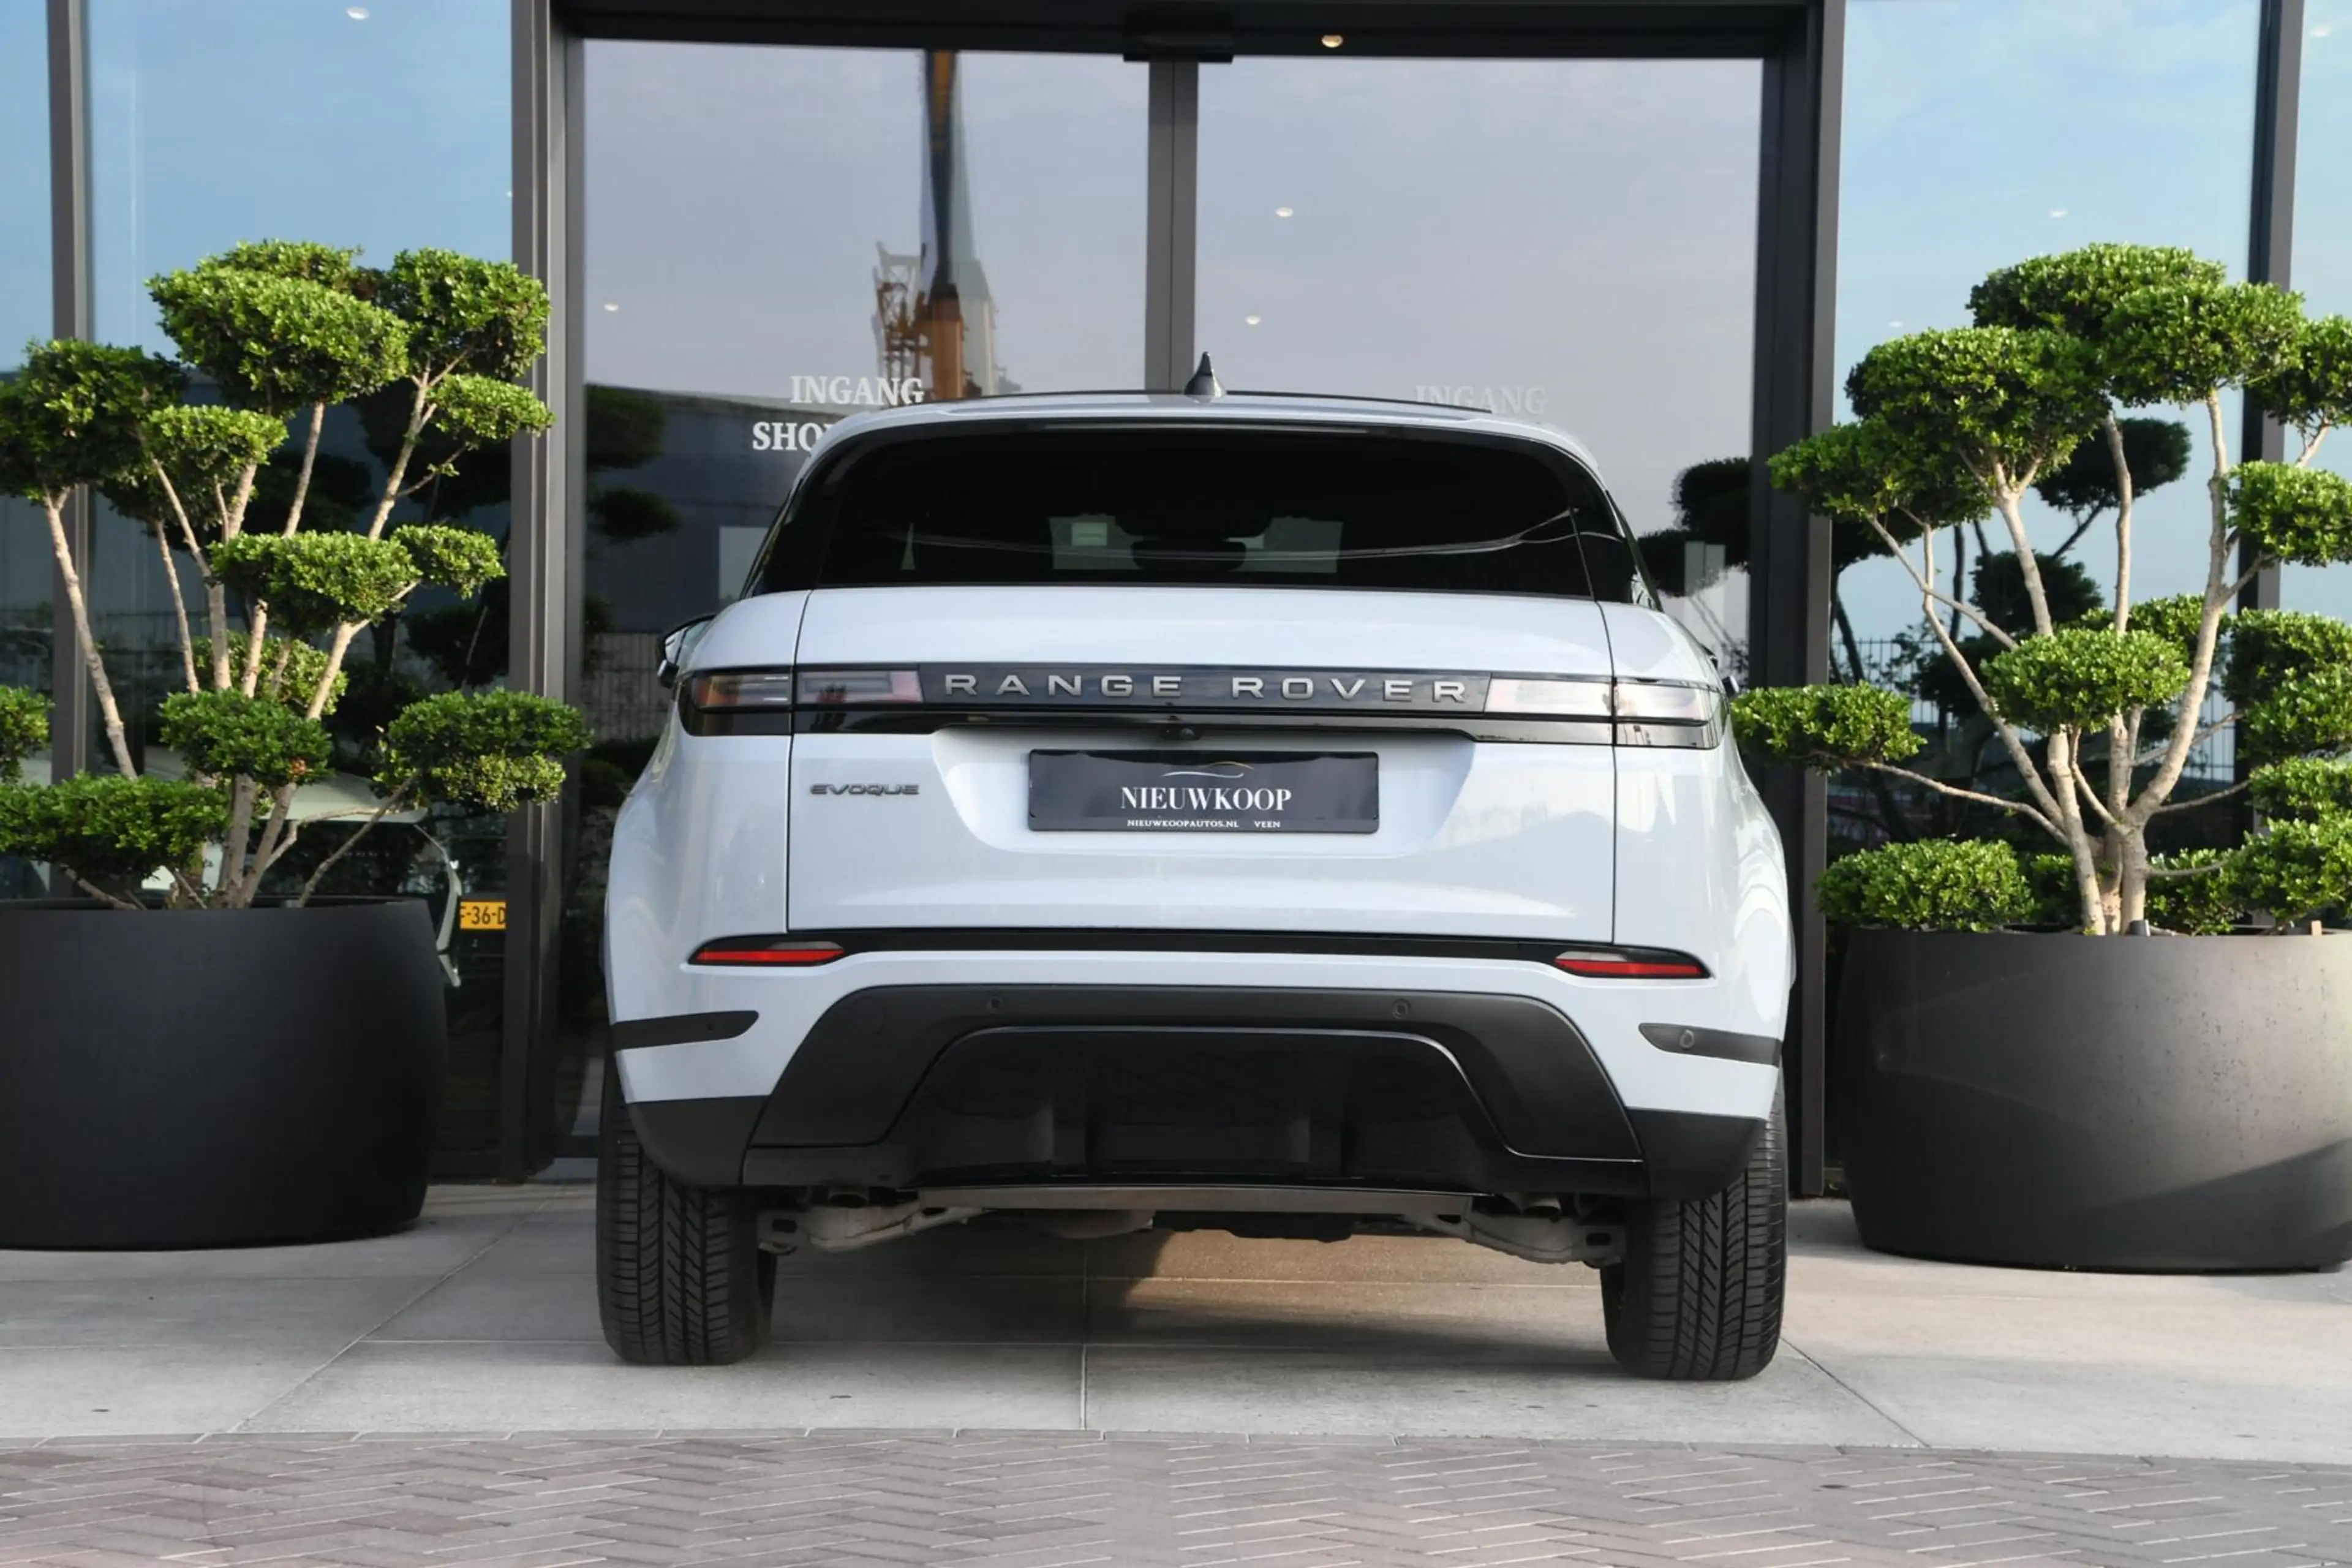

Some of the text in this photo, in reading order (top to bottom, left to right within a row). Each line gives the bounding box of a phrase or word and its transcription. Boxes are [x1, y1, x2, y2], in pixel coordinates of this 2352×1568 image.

[790, 375, 925, 405] INGANG
[1415, 385, 1547, 415] INGANG
[752, 421, 834, 451] SHO
[944, 674, 1466, 703] RANGE ROVER
[810, 783, 919, 796] EVOQUE
[1120, 787, 1292, 811] NIEUWKOOP
[1126, 819, 1239, 828] NIEUWKOOPAUTOS.NL
